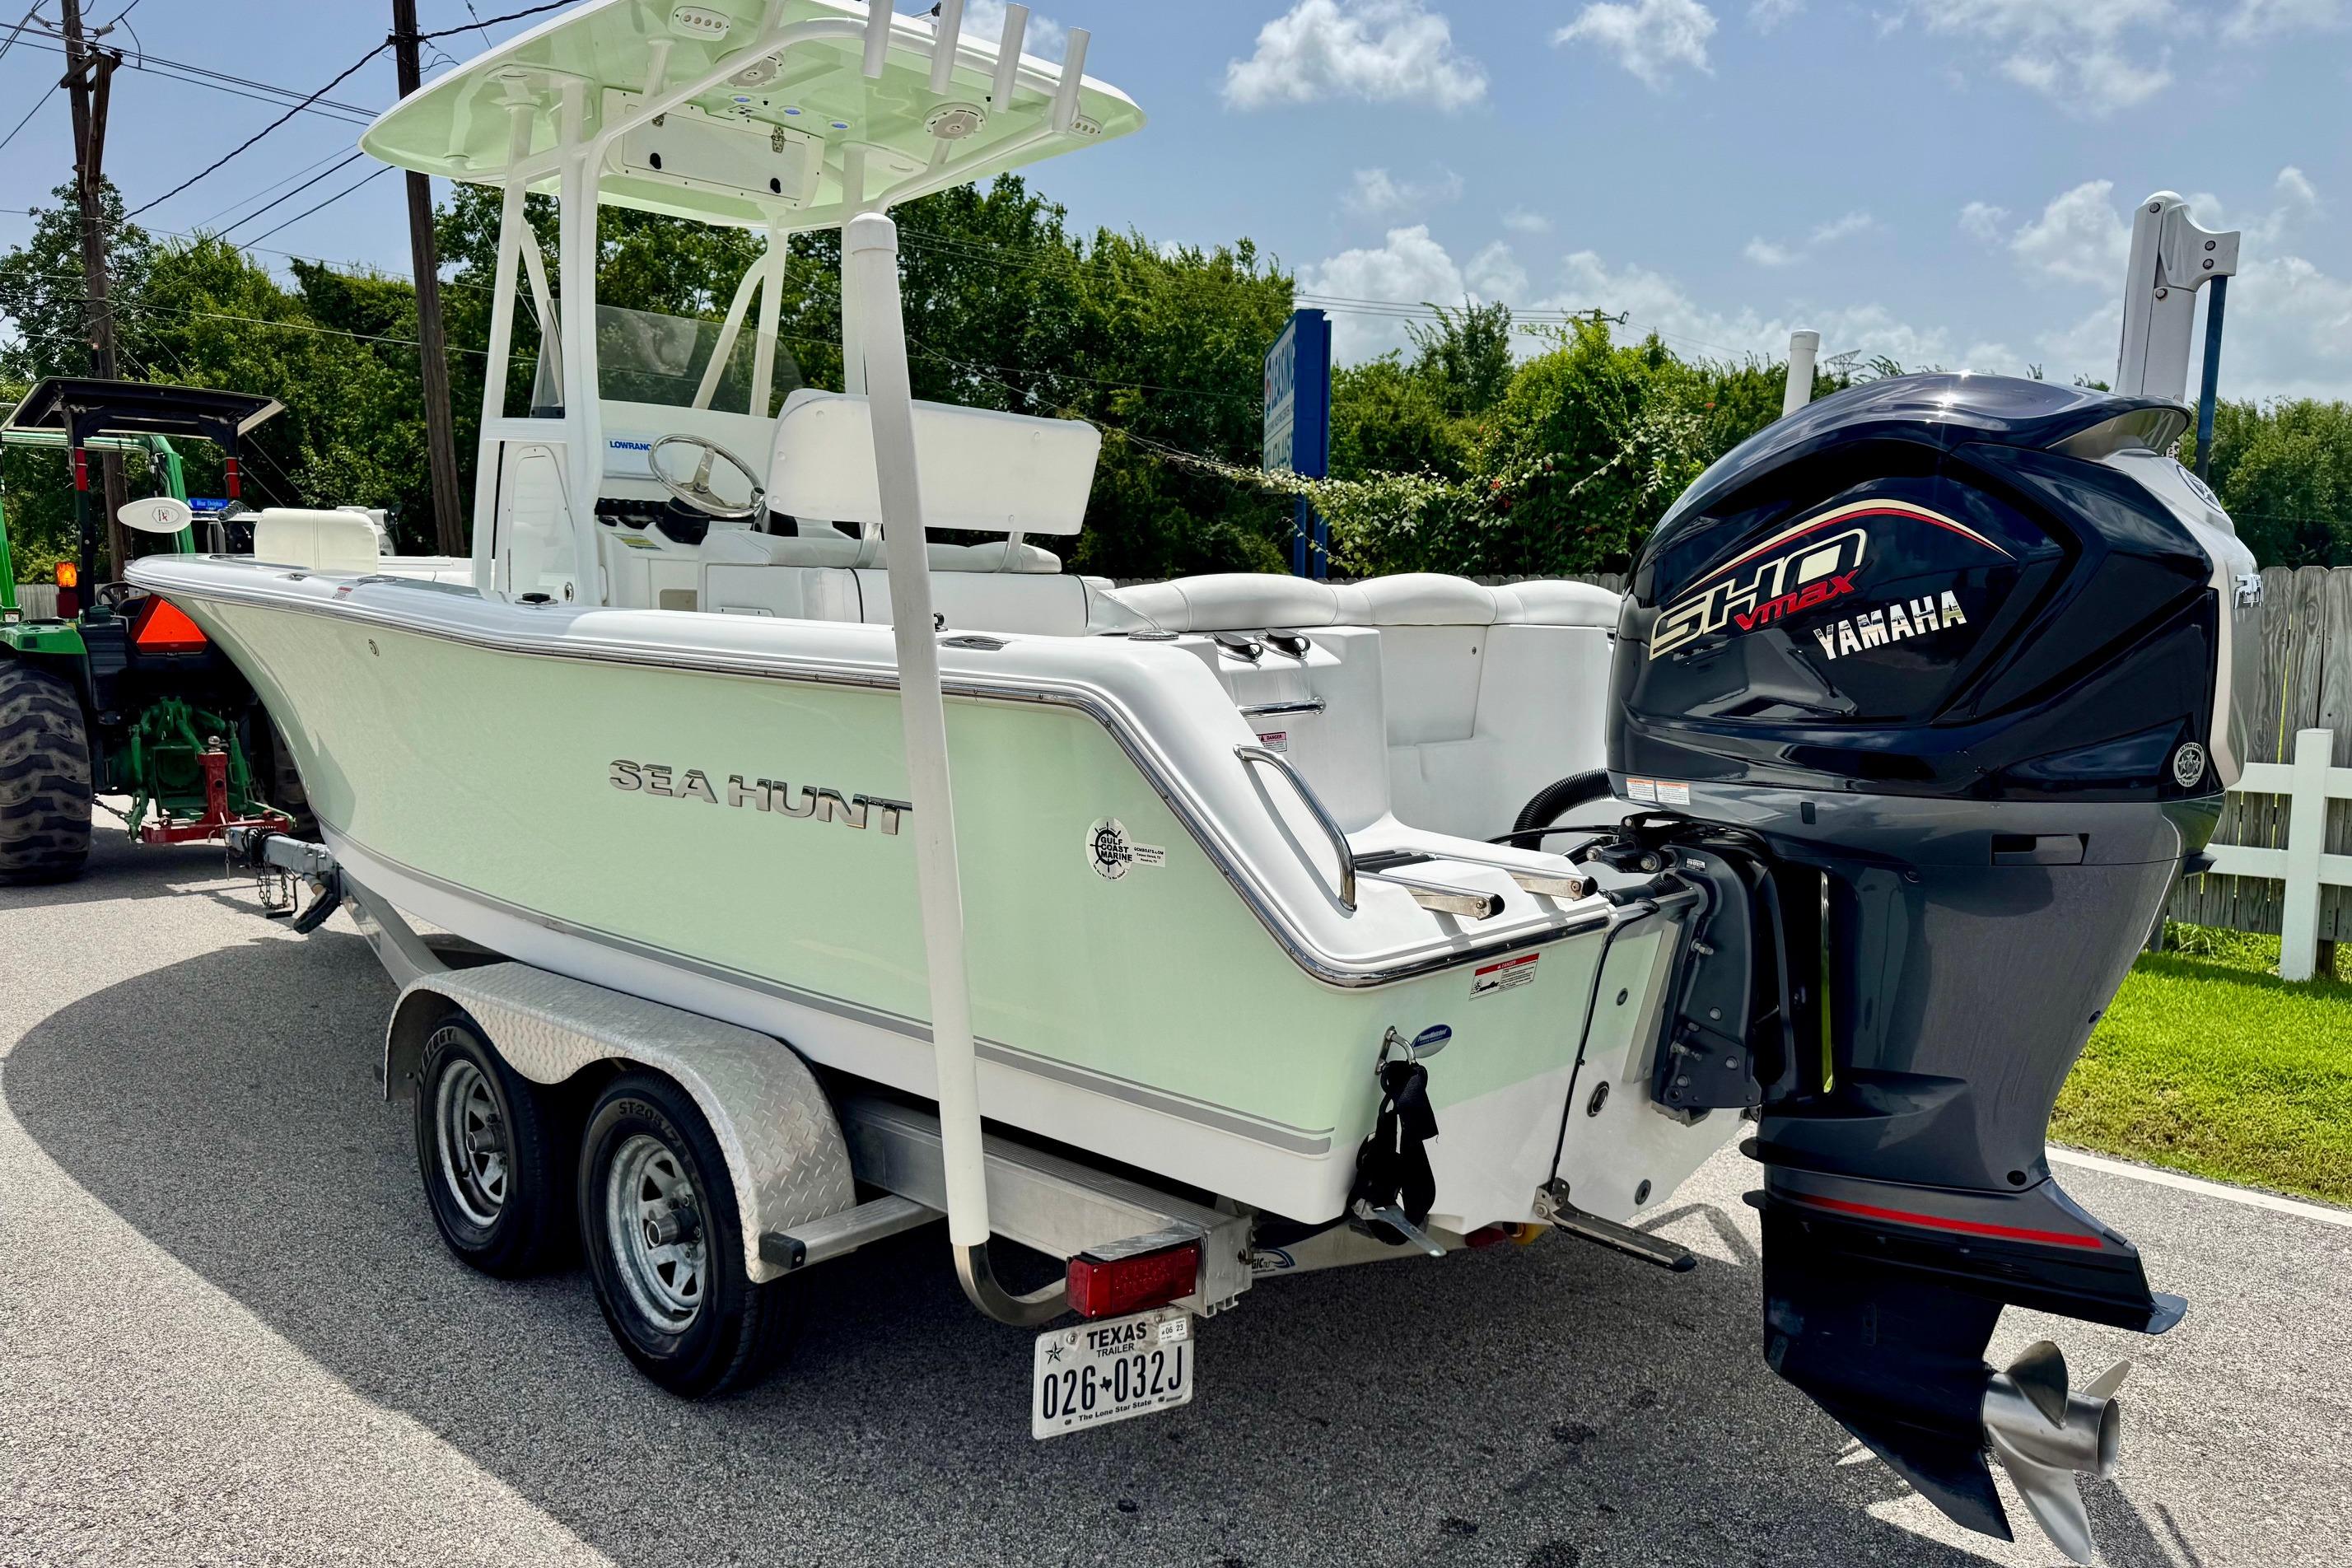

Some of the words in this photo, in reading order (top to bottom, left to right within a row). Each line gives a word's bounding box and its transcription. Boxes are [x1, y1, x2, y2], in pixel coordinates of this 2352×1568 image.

[609, 441, 652, 450] LOWRANC
[1649, 528, 1868, 660] SHO
[1813, 590, 1967, 660] YAMAHA
[609, 759, 718, 804] SEA
[728, 774, 913, 836] HUNT
[1100, 836, 1122, 846] GULF
[1101, 843, 1129, 853] COAST
[1100, 850, 1133, 862] MARINE
[1087, 1322, 1147, 1350] TEXAS
[1096, 1343, 1135, 1358] TRAILER
[1079, 1413, 1094, 1421] The
[1095, 1408, 1113, 1417] Lone
[1115, 1403, 1131, 1412] Star
[1132, 1399, 1152, 1409] State
